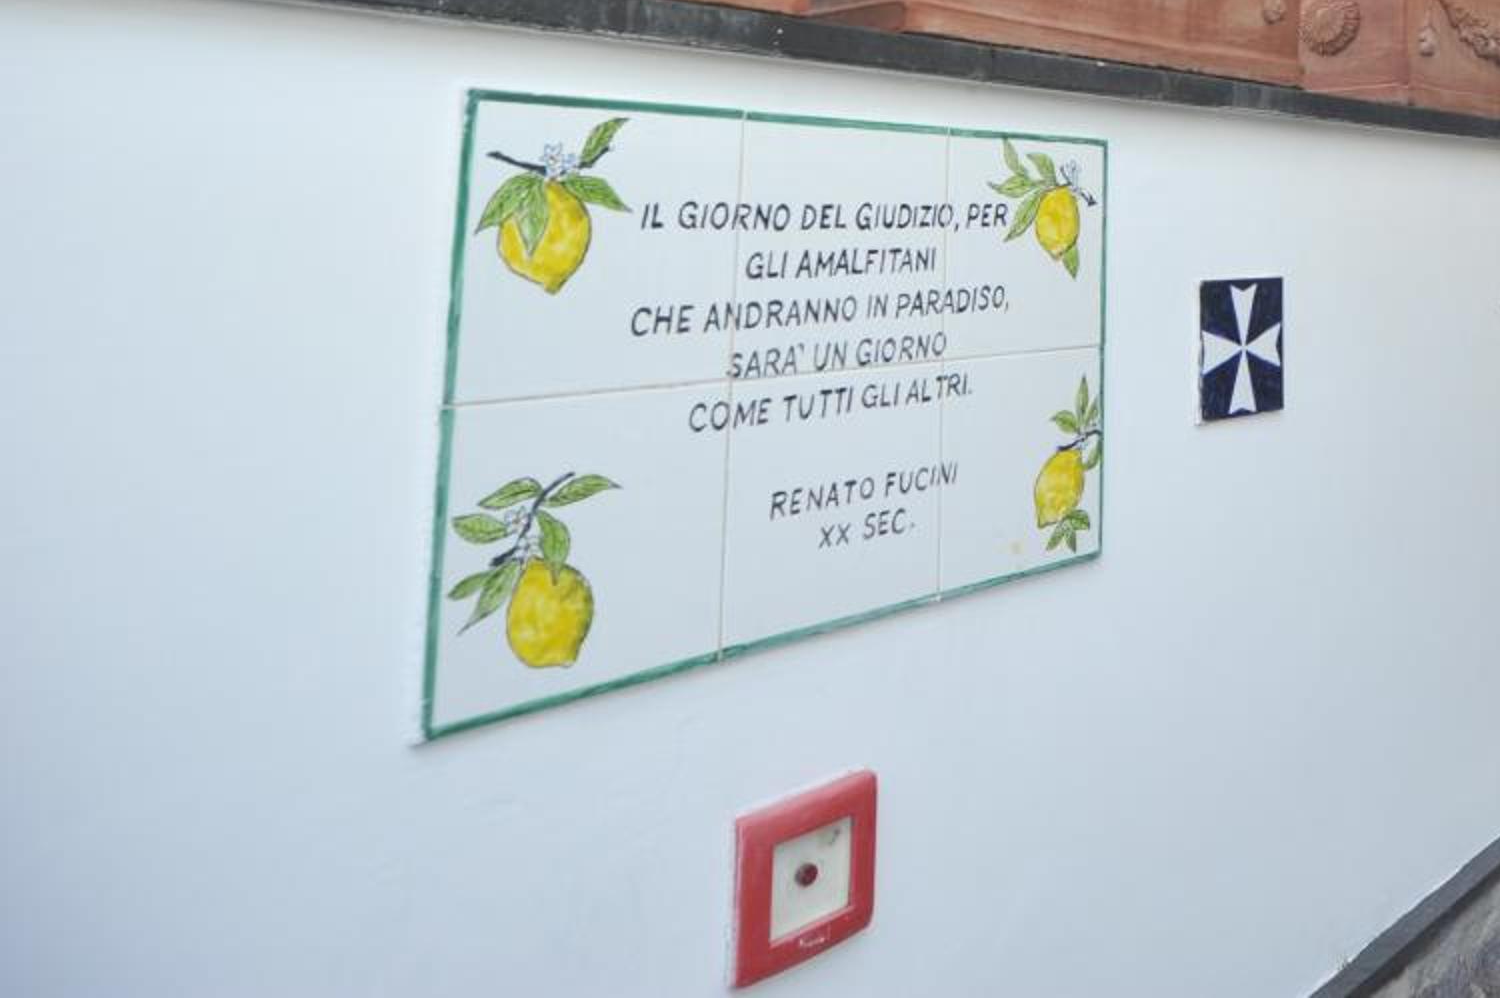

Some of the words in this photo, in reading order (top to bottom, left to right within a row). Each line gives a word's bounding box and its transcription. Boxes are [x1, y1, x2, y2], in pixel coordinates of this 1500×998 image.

[641, 202, 664, 230] IL
[678, 201, 791, 231] GIORNO
[801, 203, 847, 230] DEL
[856, 202, 960, 232] GIUDIZIO,
[966, 203, 1008, 229] PER
[746, 251, 788, 279] GLI
[796, 248, 936, 278] AMALFITANI
[630, 304, 693, 336] CHE
[703, 296, 857, 333] ANDRANNO
[867, 294, 888, 319] IN
[895, 285, 1009, 319] PARADISO,
[814, 341, 847, 372] UN
[856, 331, 947, 367] GIORNO
[689, 397, 772, 432] COME
[783, 386, 853, 422] TUTTI
[861, 382, 900, 409] GLI
[769, 477, 875, 521] RENATO
[885, 460, 958, 497] FUCINI
[818, 522, 851, 549] XX
[863, 508, 915, 540] SEC.
